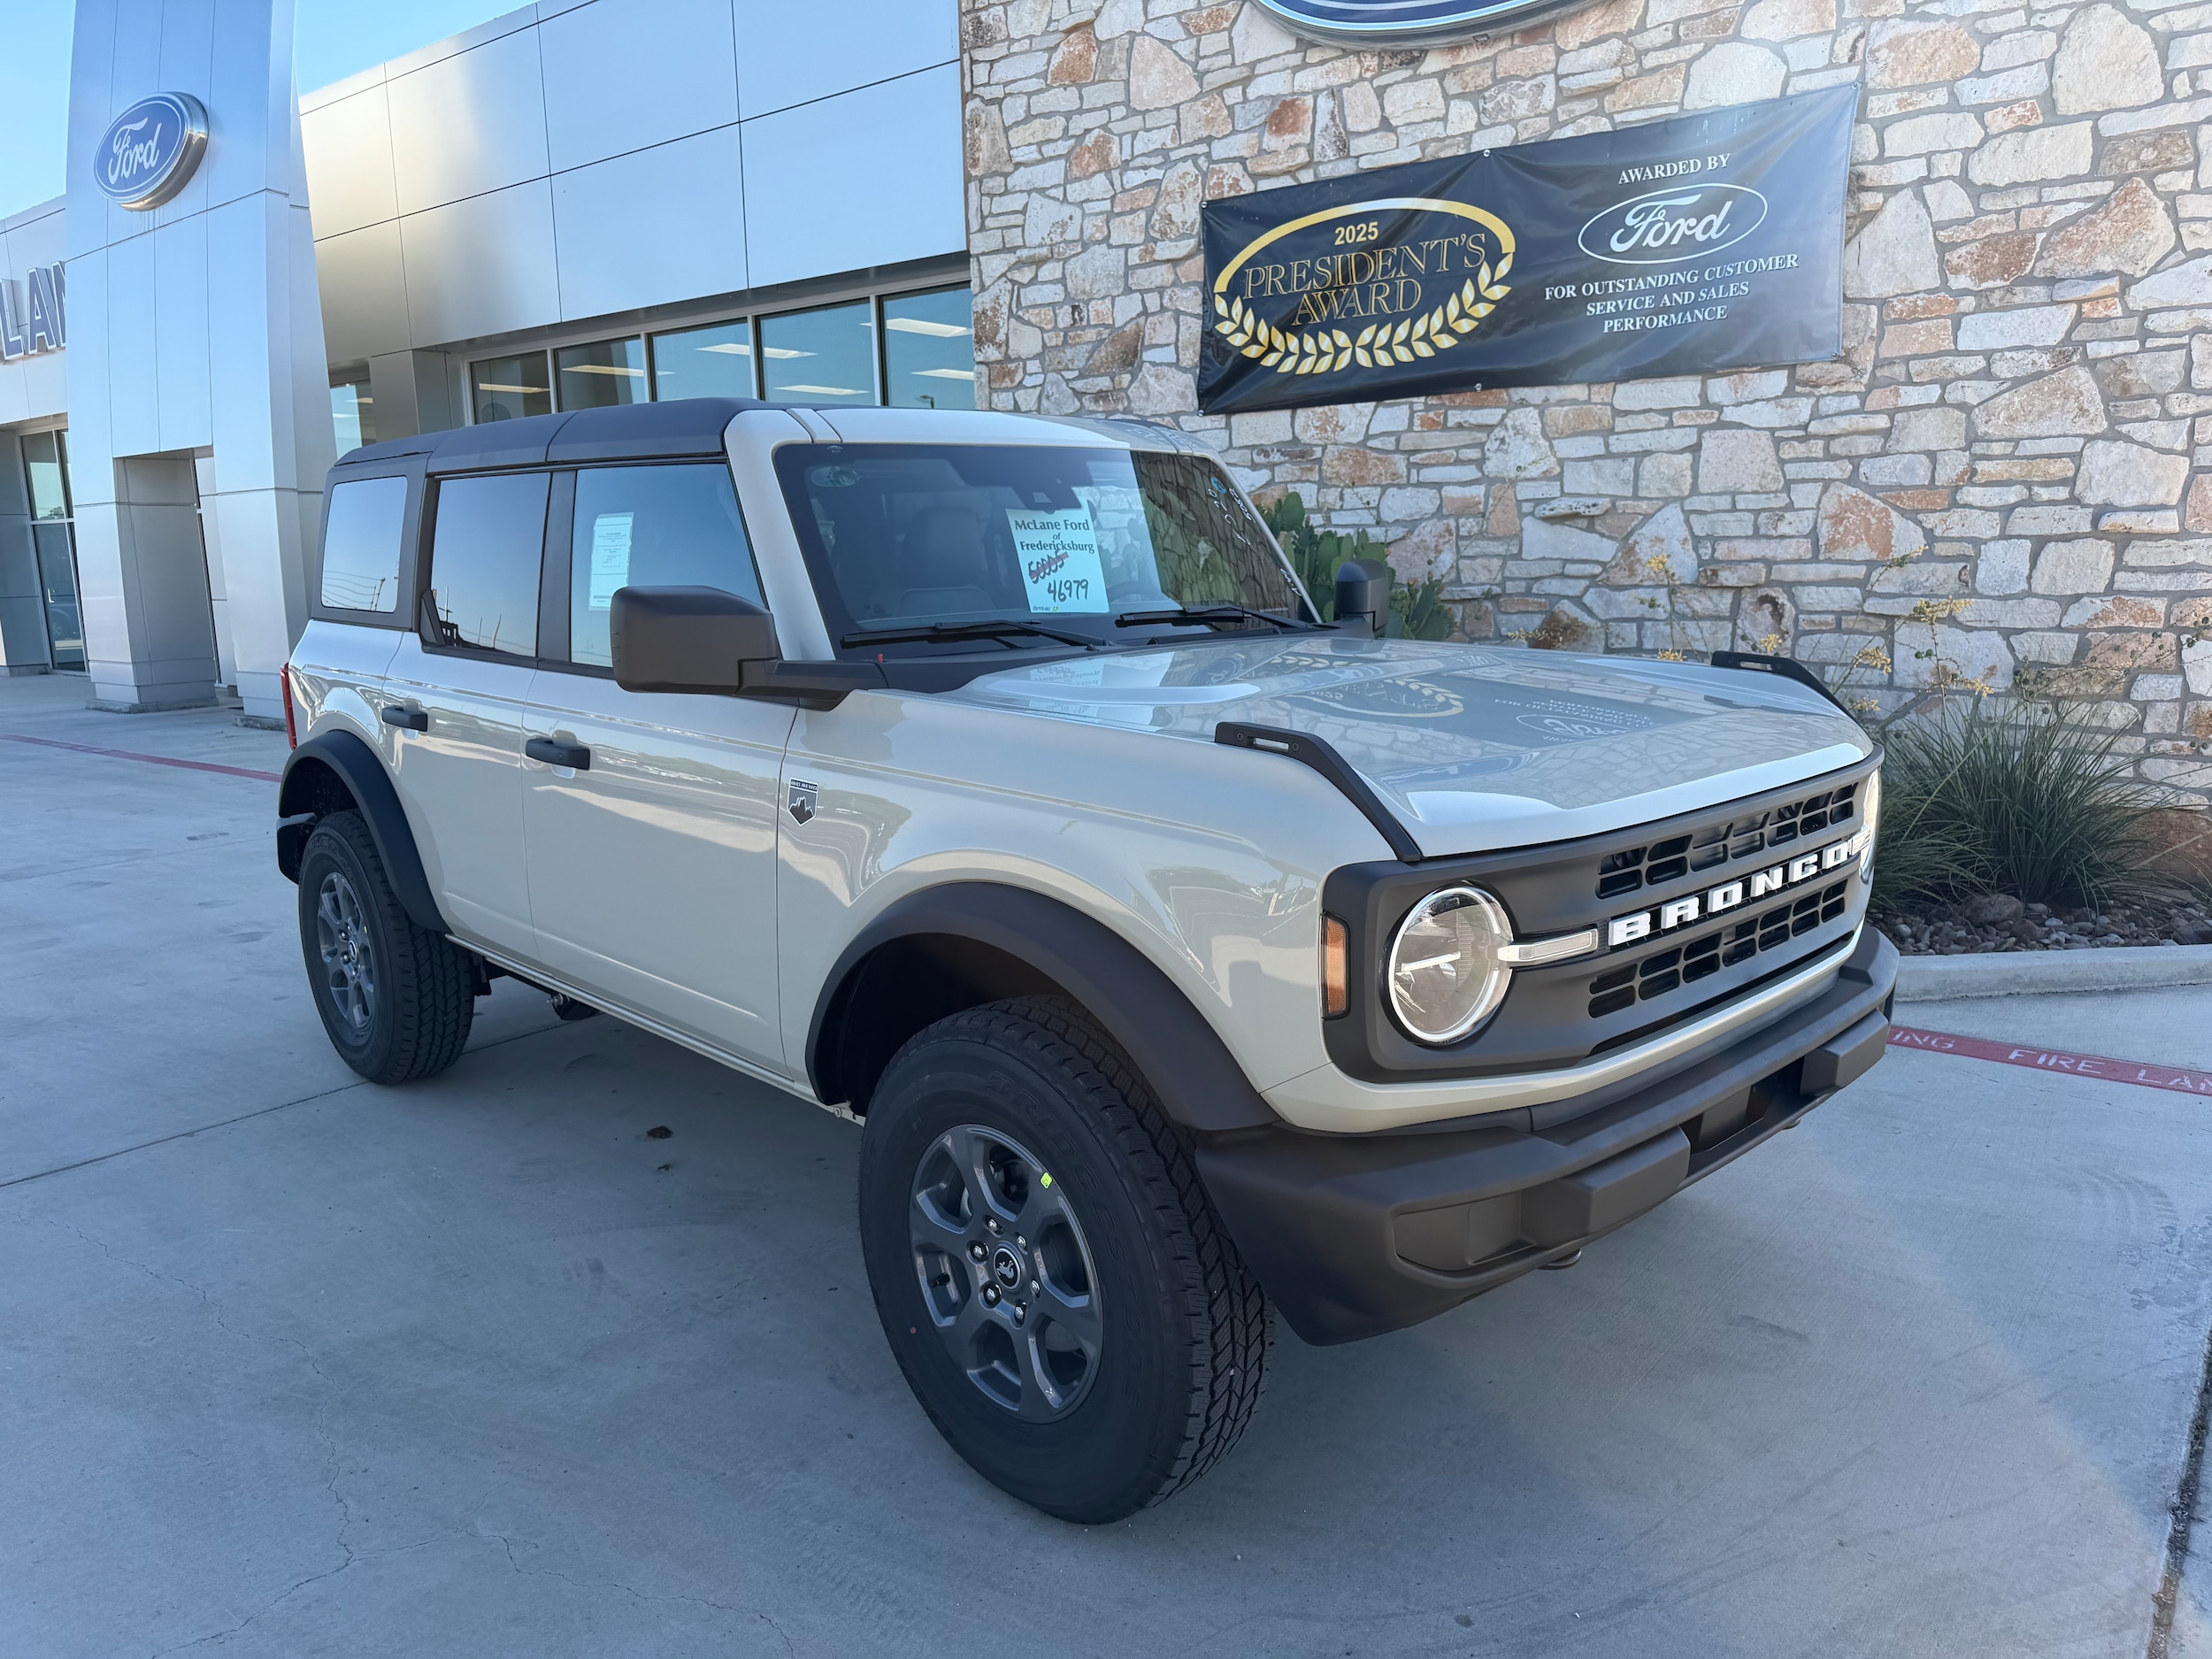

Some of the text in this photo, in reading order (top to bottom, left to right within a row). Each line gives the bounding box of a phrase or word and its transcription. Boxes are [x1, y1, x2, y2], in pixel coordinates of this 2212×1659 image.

[108, 117, 162, 185] Ford
[1618, 153, 1732, 184] AWARDED BY
[1334, 221, 1379, 245] 2025
[1609, 193, 1733, 252] Ford
[1243, 233, 1486, 299] PRESIDENT'S
[1544, 254, 1799, 300] FOR OUTSTANDING CUSTOMER
[1291, 278, 1421, 326] AWARD
[1586, 281, 1749, 316] SERVICE AND SALES
[1602, 305, 1728, 333] PERFORMANCE
[1015, 519, 1090, 531] McLane Ford
[1053, 532, 1062, 541] of
[1019, 541, 1094, 554] Fredericksburg
[1048, 579, 1089, 603] 46979
[1609, 841, 1848, 946] BRONCO
[2008, 1048, 2105, 1074] FIRE
